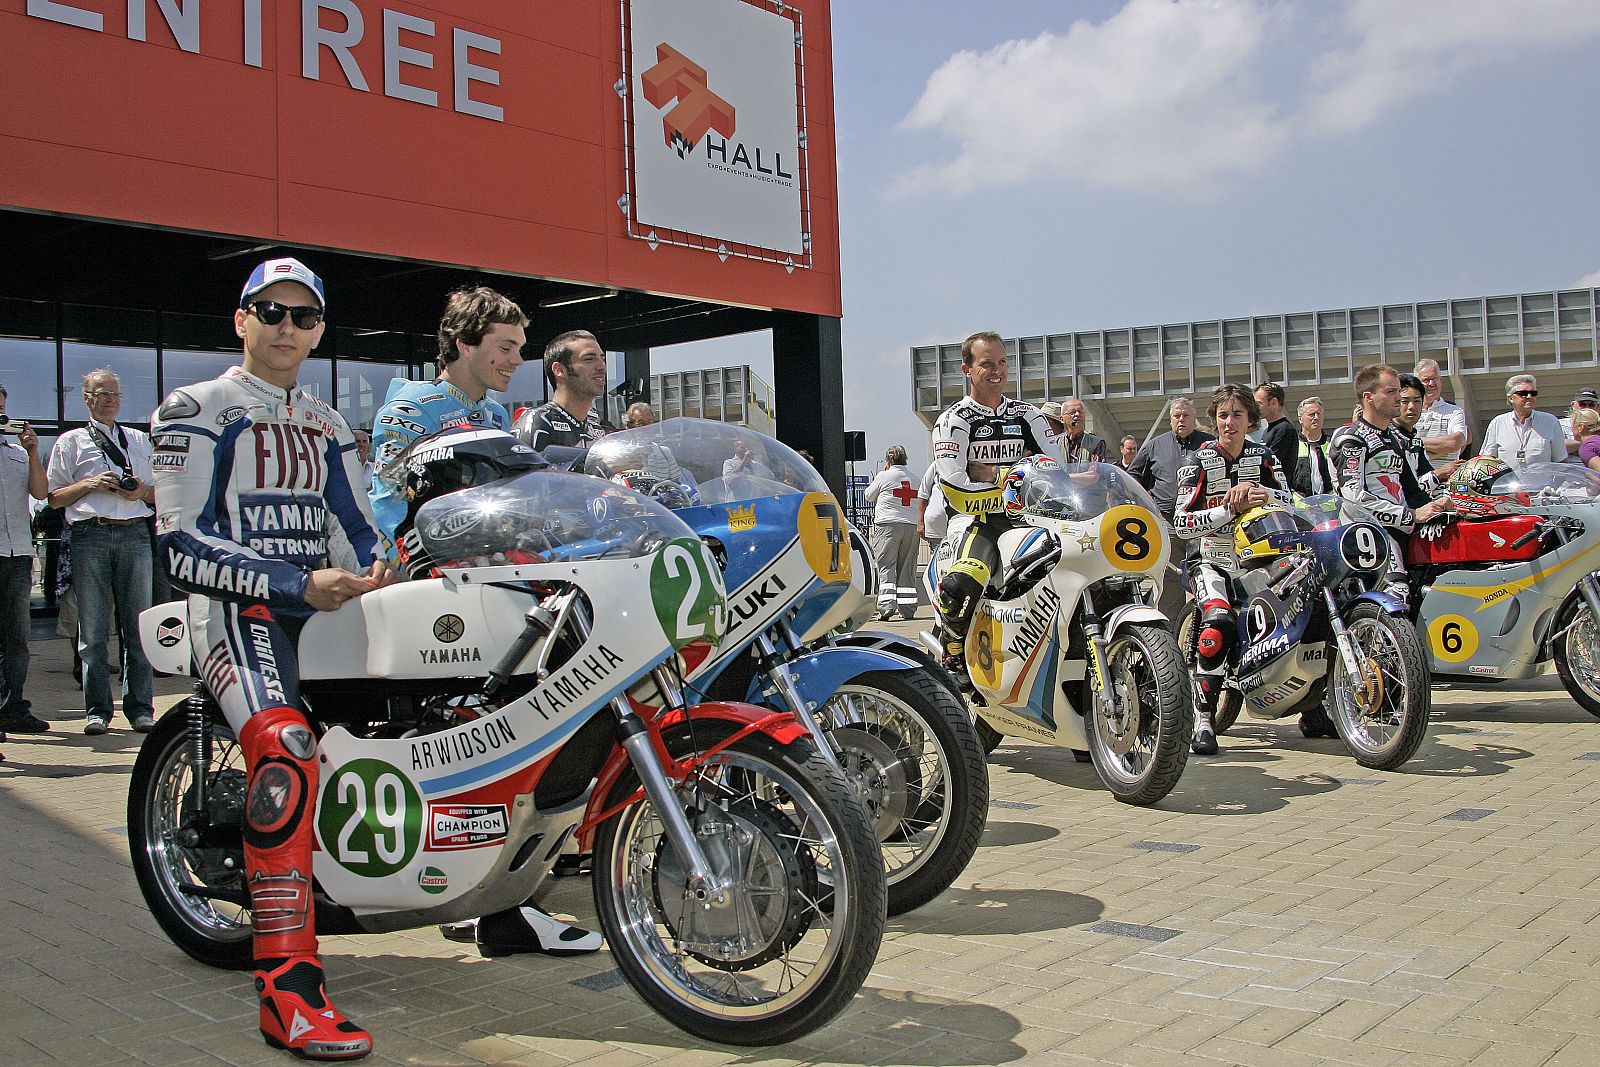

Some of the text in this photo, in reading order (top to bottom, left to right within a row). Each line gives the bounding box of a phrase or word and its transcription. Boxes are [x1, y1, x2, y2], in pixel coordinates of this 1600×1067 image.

[706, 134, 792, 179] HALL
[221, 409, 243, 425] X-lite
[252, 423, 324, 492] FIAT
[973, 443, 1021, 460] YAMAHA
[729, 516, 756, 530] KING
[813, 503, 844, 573] 7
[1114, 517, 1150, 560] 8
[1355, 527, 1377, 569] 9
[168, 548, 270, 600] YAMAHA
[726, 573, 787, 636] ZUKI
[1483, 588, 1509, 604] HONDA
[1008, 585, 1061, 662] YAMAHA
[1253, 604, 1267, 642] 9
[1441, 622, 1463, 653] 6
[419, 647, 482, 664] YAMAHA
[977, 630, 993, 671] 8
[1241, 633, 1290, 666] HERIMA
[410, 643, 623, 771] ARWIDSON YAMAHA
[1250, 684, 1293, 710] Mobil
[337, 771, 406, 865] 29
[437, 818, 501, 832] CHAMPION
[421, 876, 448, 885] Castrol
